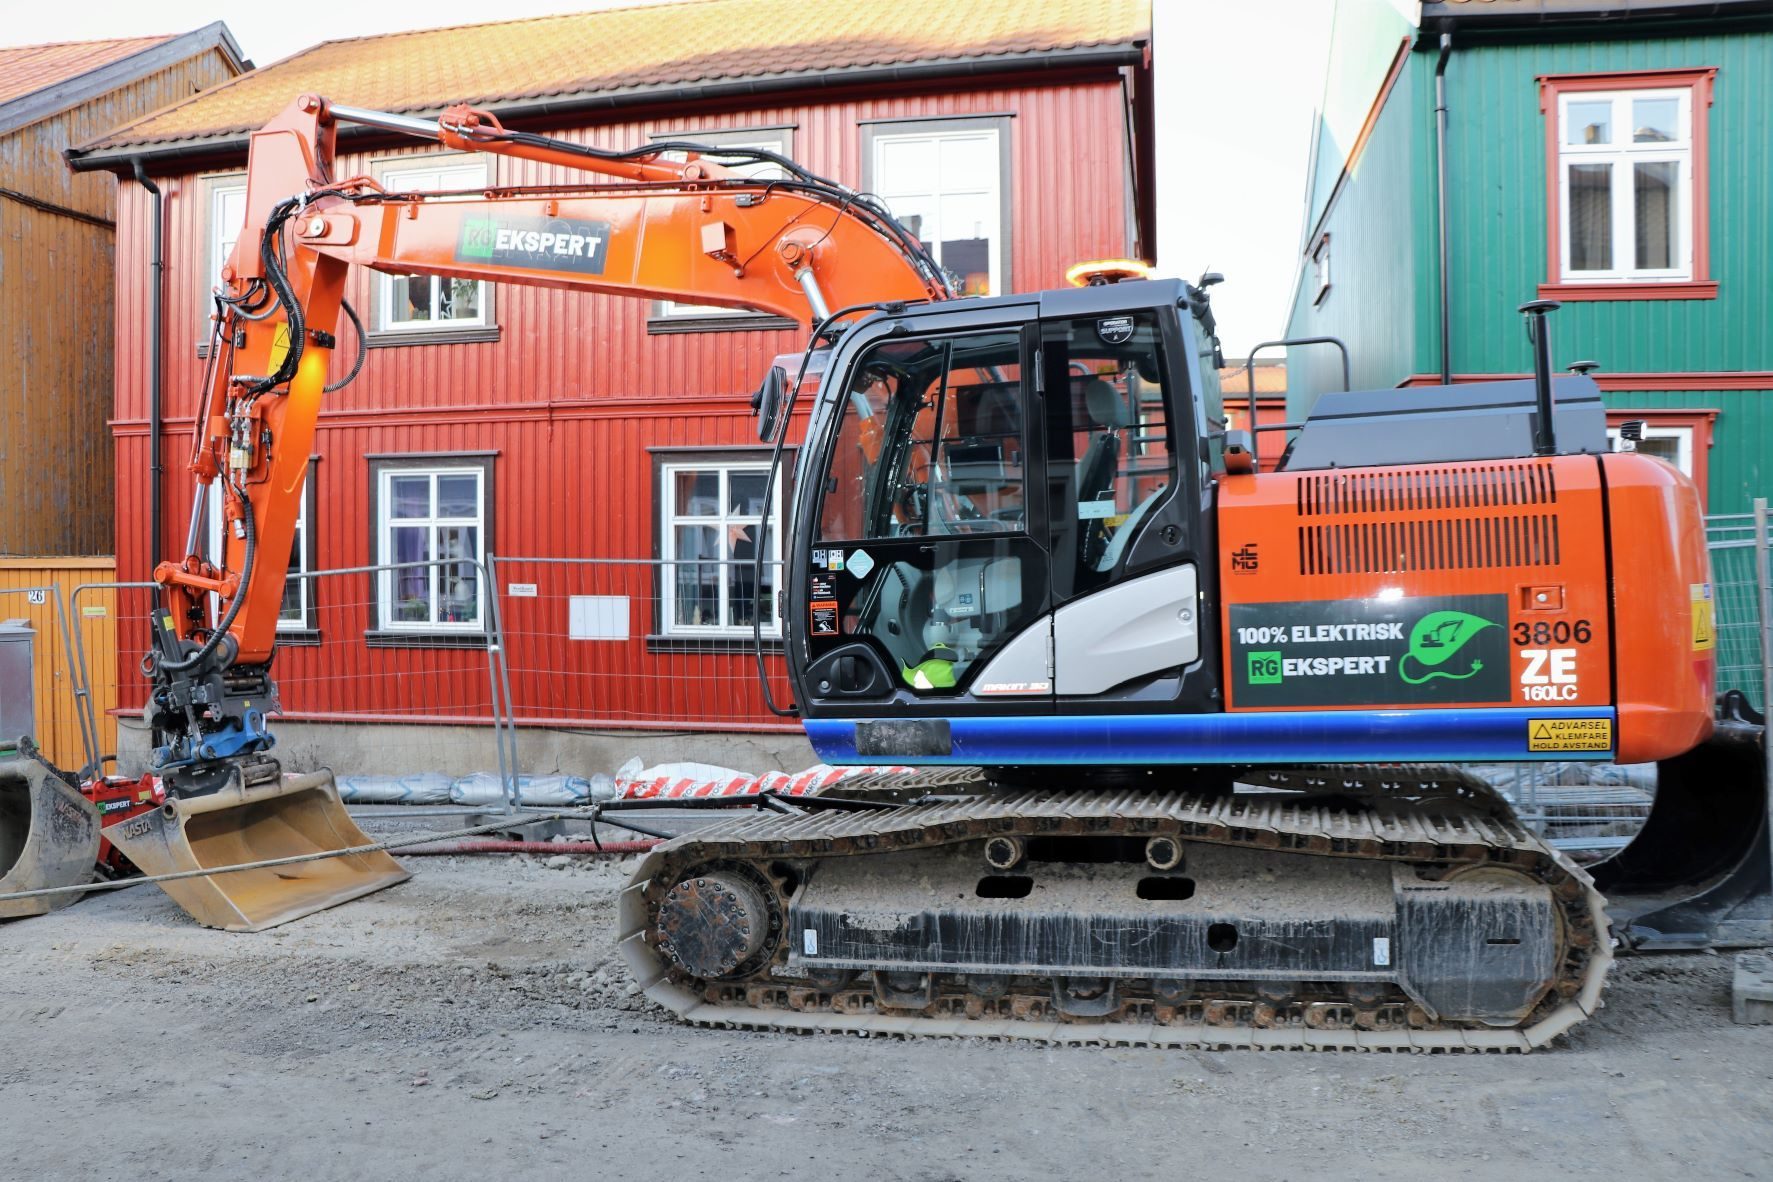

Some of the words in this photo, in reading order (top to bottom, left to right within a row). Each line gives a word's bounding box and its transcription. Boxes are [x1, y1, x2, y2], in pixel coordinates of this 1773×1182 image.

[495, 229, 601, 258] EKSPERT
[29, 590, 43, 602] 26
[1238, 626, 1288, 645] 100%
[1291, 622, 1404, 643] ELEKTRISK
[1513, 619, 1592, 646] 3806
[1251, 659, 1279, 677] RG
[1282, 655, 1391, 677] EKSPERT
[1520, 648, 1577, 684] ZE
[1521, 684, 1578, 701] 160LC
[1551, 721, 1608, 730] ADVARSEL
[1533, 742, 1560, 750] HOLD
[1562, 741, 1608, 749] AVSTAND
[1555, 732, 1608, 740] KLEMFARE
[105, 800, 131, 811] EKSPERT
[123, 820, 153, 841] NASTA
